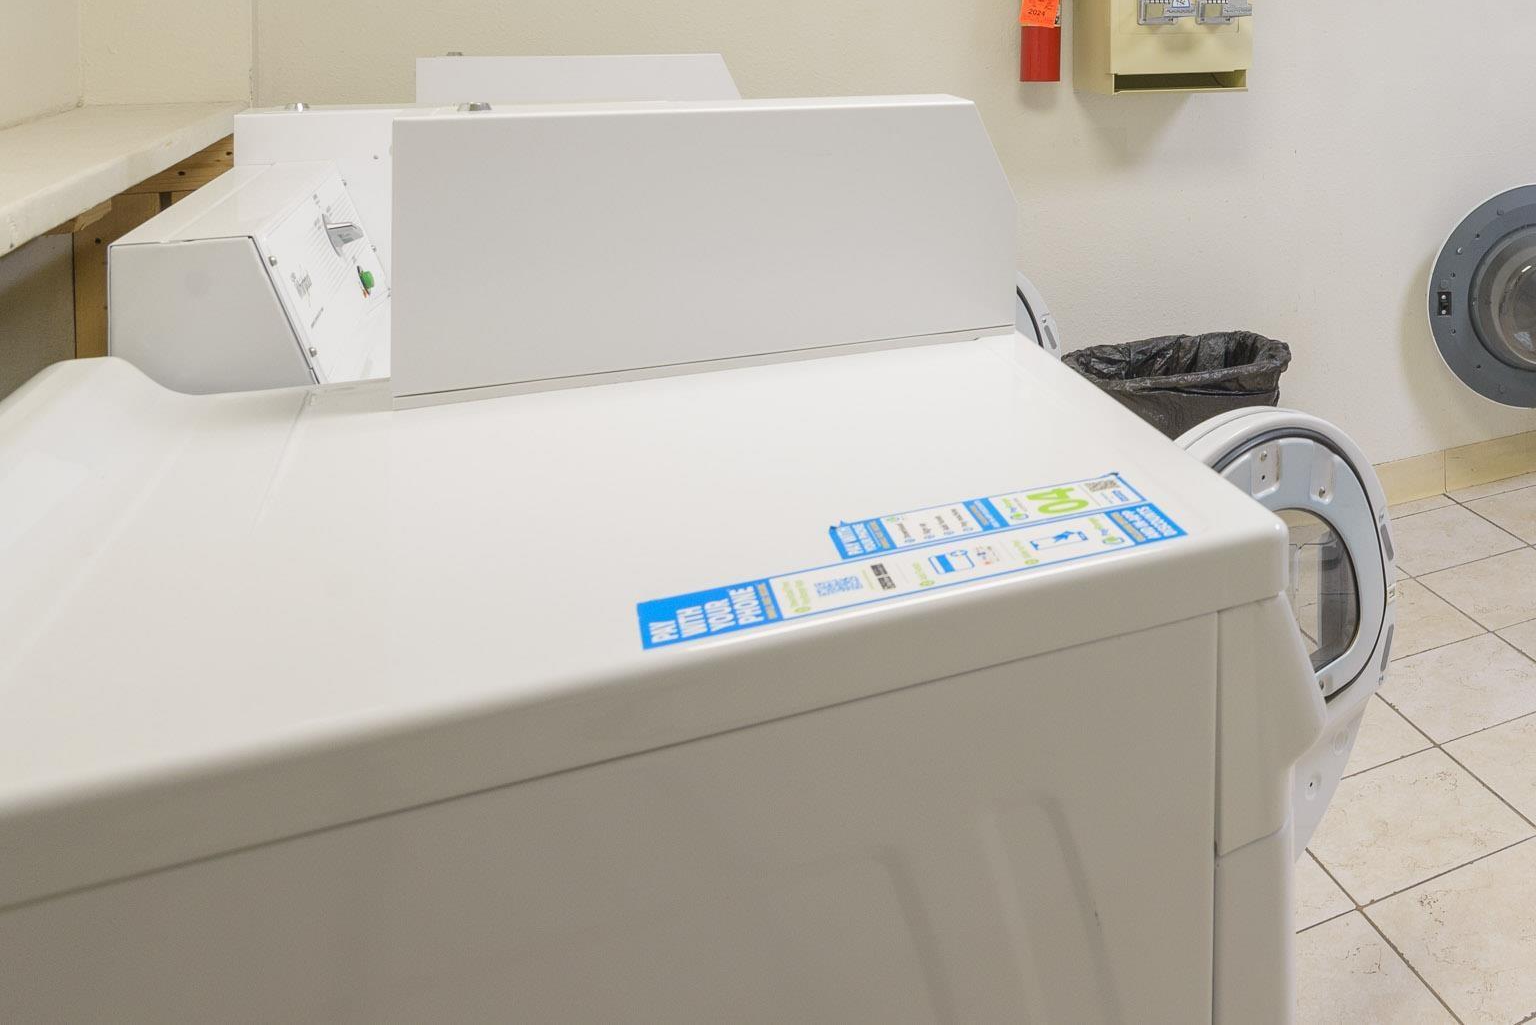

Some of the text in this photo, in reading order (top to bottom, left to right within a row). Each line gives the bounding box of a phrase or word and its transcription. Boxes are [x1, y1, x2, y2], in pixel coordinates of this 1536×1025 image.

[676, 605, 708, 638] WITH
[703, 598, 737, 633] YOUR
[728, 586, 765, 625] PHONE
[649, 620, 679, 644] PAY
